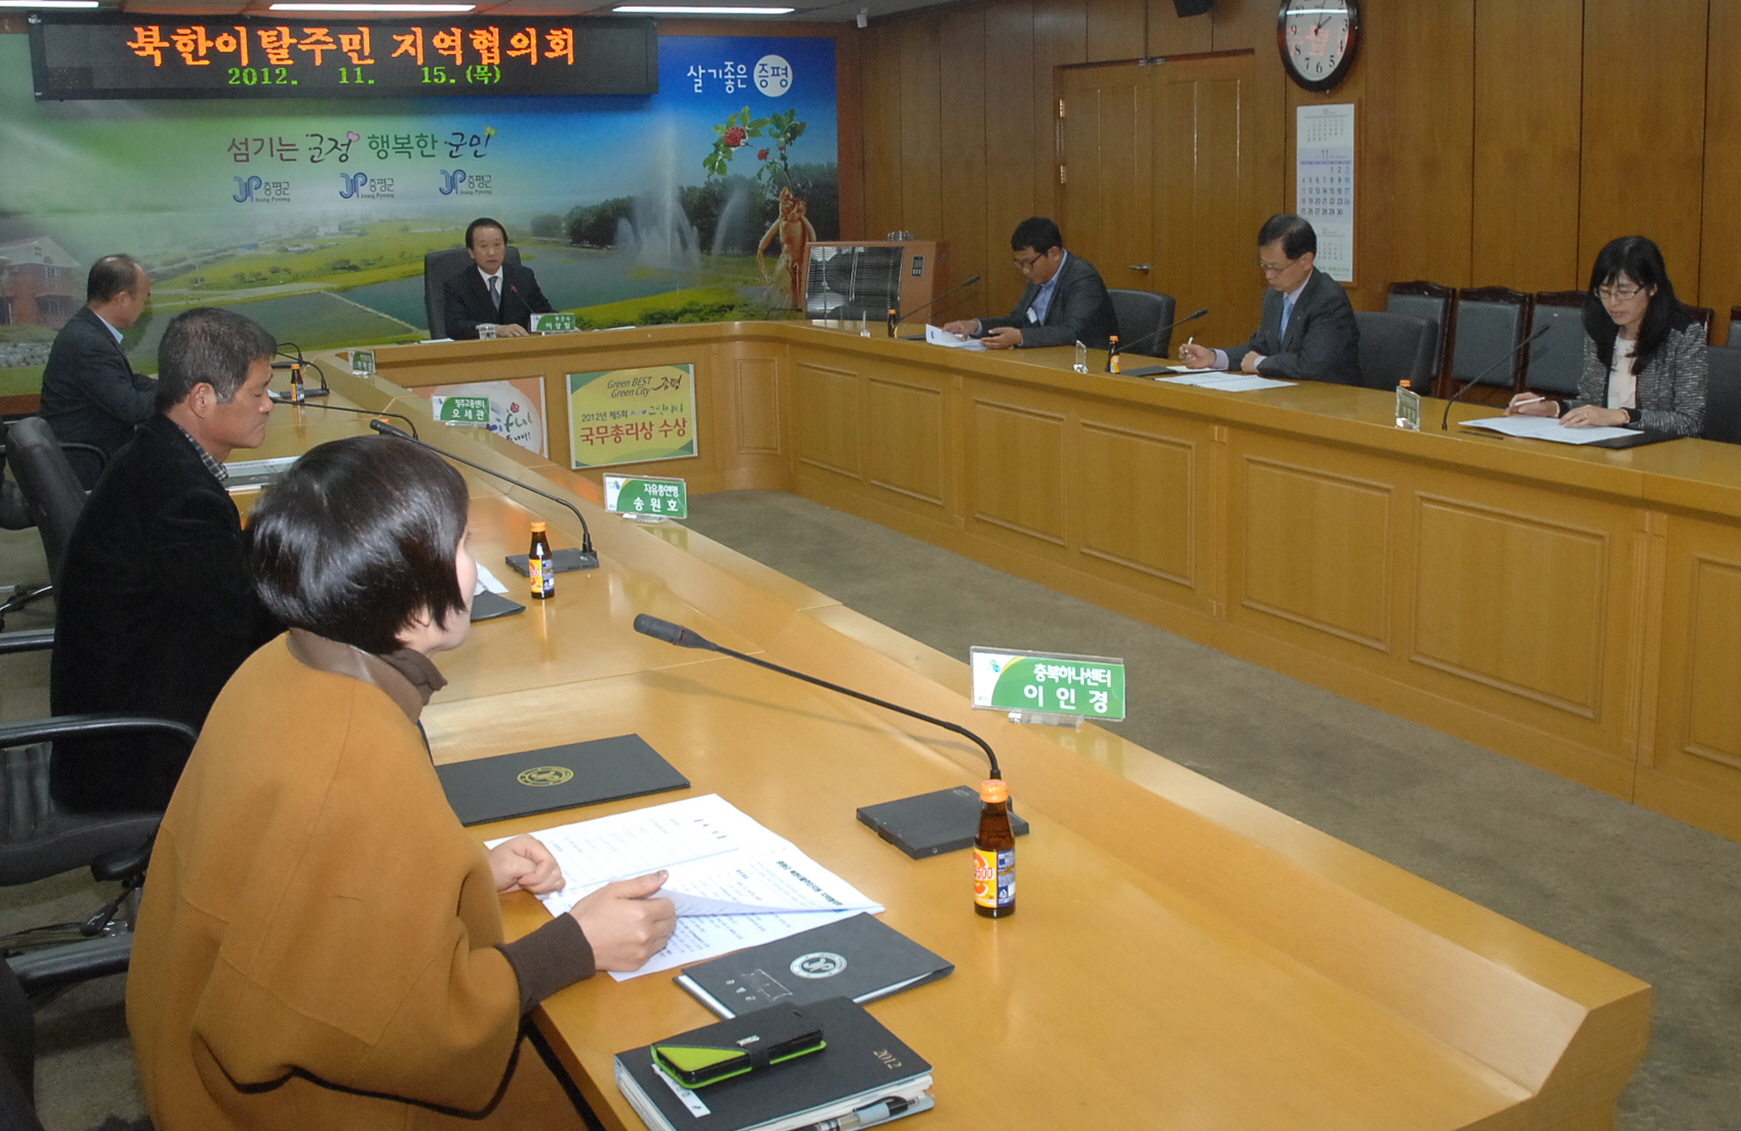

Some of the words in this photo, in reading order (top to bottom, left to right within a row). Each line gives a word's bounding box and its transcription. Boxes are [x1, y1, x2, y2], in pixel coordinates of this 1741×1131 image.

[1291, 25, 1297, 36] 9
[1342, 19, 1349, 32] 3
[127, 26, 375, 67] 북한이탈주민
[391, 26, 574, 66] 지역협의회
[1295, 45, 1301, 56] 8
[1338, 40, 1343, 52] 4
[1305, 58, 1311, 70] 7
[1316, 61, 1323, 74] 6
[1329, 55, 1336, 68] 5
[228, 67, 298, 85] 2012.
[339, 67, 375, 84] 11.
[758, 63, 789, 89] 증평
[227, 136, 300, 163] 섬기는
[305, 132, 354, 164] 군정
[367, 132, 438, 160] 행복한
[444, 132, 492, 159] 군민
[264, 181, 290, 196] 증평군
[369, 178, 395, 192] 증평군
[468, 174, 492, 189] 증평군
[607, 379, 631, 390] Green
[631, 376, 653, 387] BEST
[611, 388, 635, 398] Green
[635, 386, 652, 398] City
[581, 411, 608, 422] 2012년
[608, 410, 628, 421] 제5회
[580, 420, 655, 446] 국무총리상
[658, 417, 688, 438] 수상
[643, 483, 679, 498] 자유총연맹
[1033, 662, 1112, 687] 충북하나센터
[872, 1048, 903, 1070] 2012
